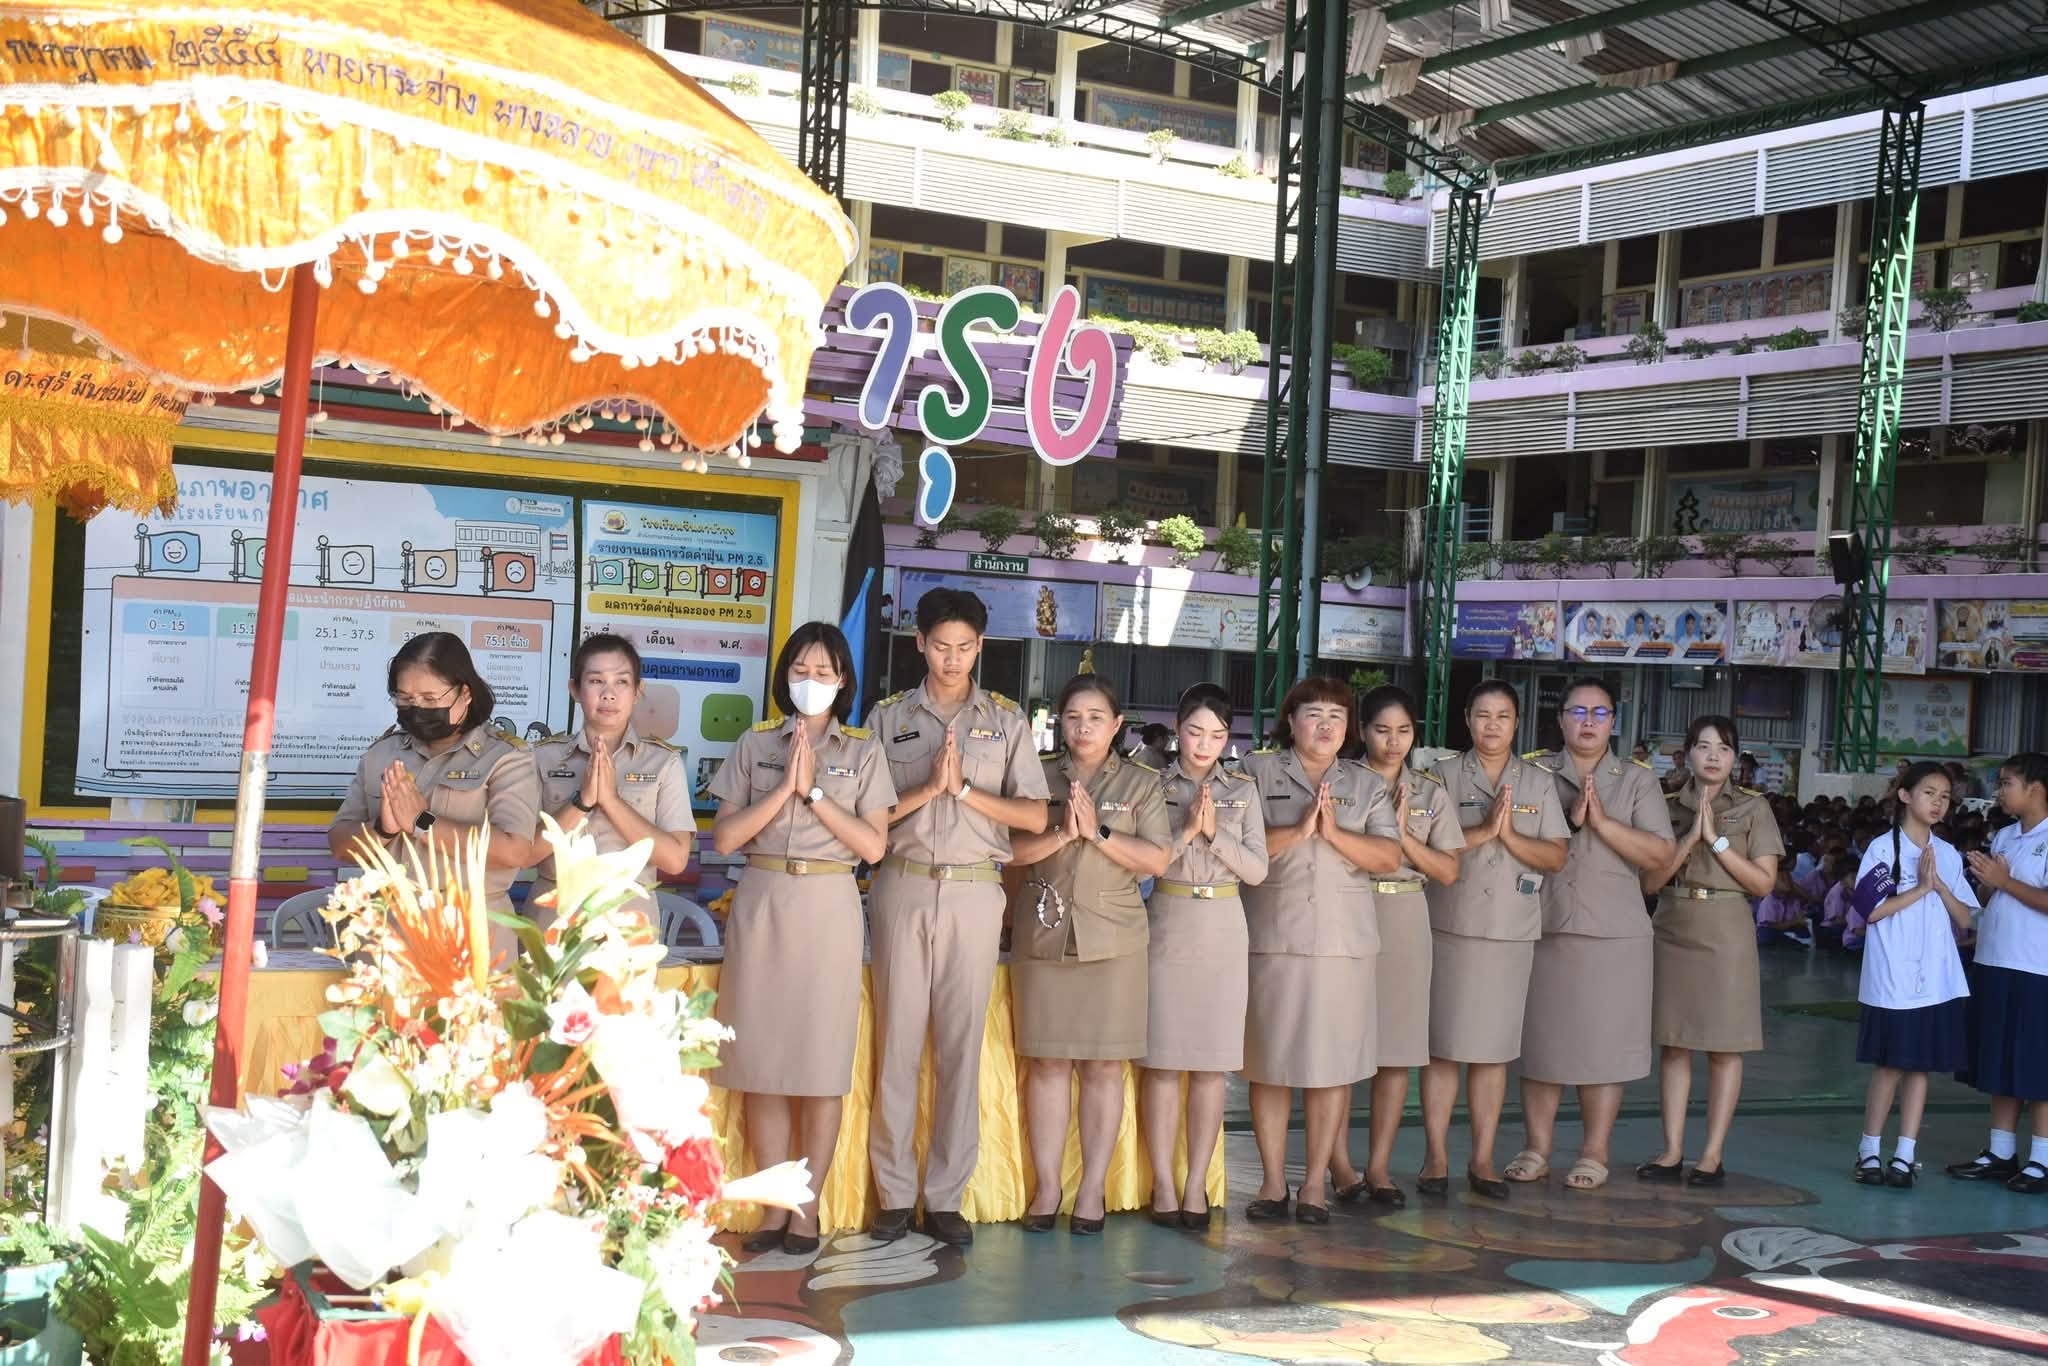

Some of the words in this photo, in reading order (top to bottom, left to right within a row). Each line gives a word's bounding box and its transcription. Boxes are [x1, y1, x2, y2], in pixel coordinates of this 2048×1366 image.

[846, 282, 1117, 525] ารุง
[177, 479, 329, 511] ภาพอาาศ
[599, 543, 723, 565] รายงานผลการวัดค่าฝุ่น
[728, 553, 743, 563] PM
[748, 556, 763, 565] 2.5
[974, 555, 1024, 572] สำนักงาน
[604, 599, 716, 618] ผลการวัดค่าฝุ่นละออง
[719, 608, 734, 617] PM
[737, 608, 752, 618] 2.5
[149, 619, 157, 630] 0
[172, 620, 185, 631] 15
[232, 623, 254, 634] 15.1
[315, 627, 338, 639] 25.1
[351, 629, 374, 640] 37.5
[485, 635, 506, 647] 75.1
[583, 623, 611, 639] วัี่
[646, 630, 675, 646] เดือน
[719, 638, 743, 650] พ.ศ.
[641, 661, 736, 679] บคุณภาพอากาศ
